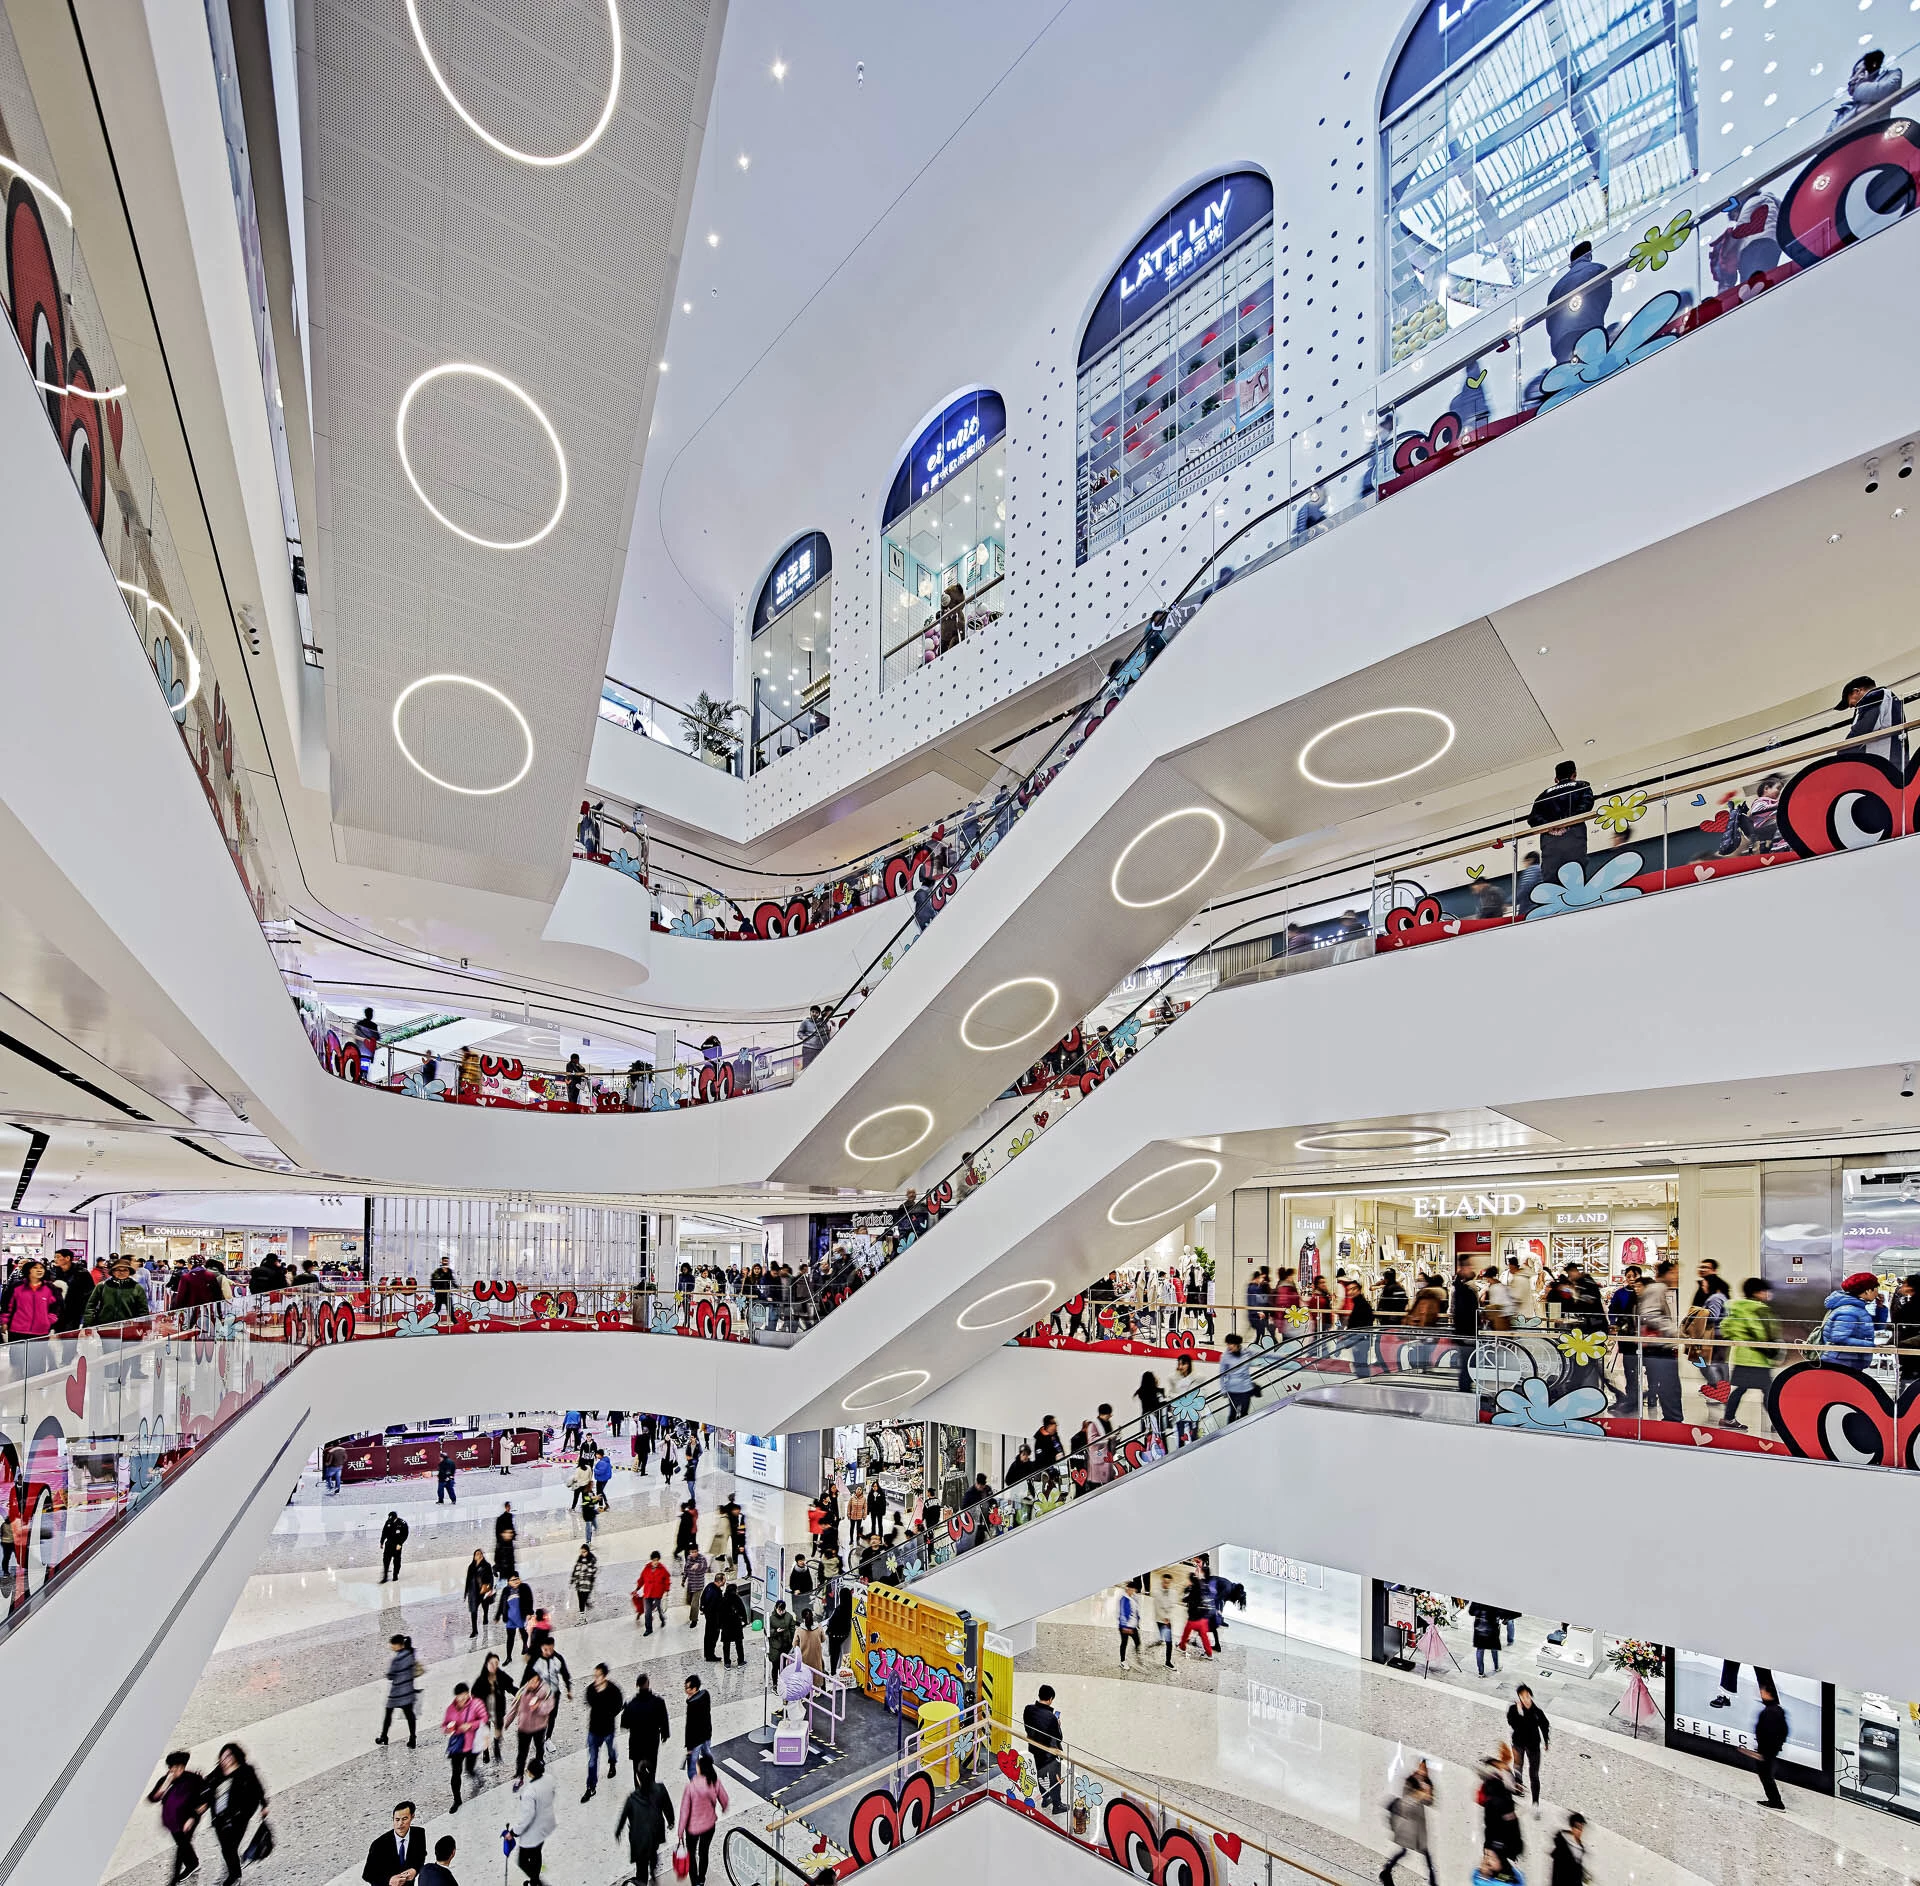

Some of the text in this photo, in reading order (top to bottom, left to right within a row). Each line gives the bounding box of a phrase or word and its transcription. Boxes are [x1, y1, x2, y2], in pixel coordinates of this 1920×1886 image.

[1120, 188, 1231, 300] LÄTT LIV
[1164, 222, 1224, 282] 生活无忧
[1676, 1717, 1758, 1746] SELEC
